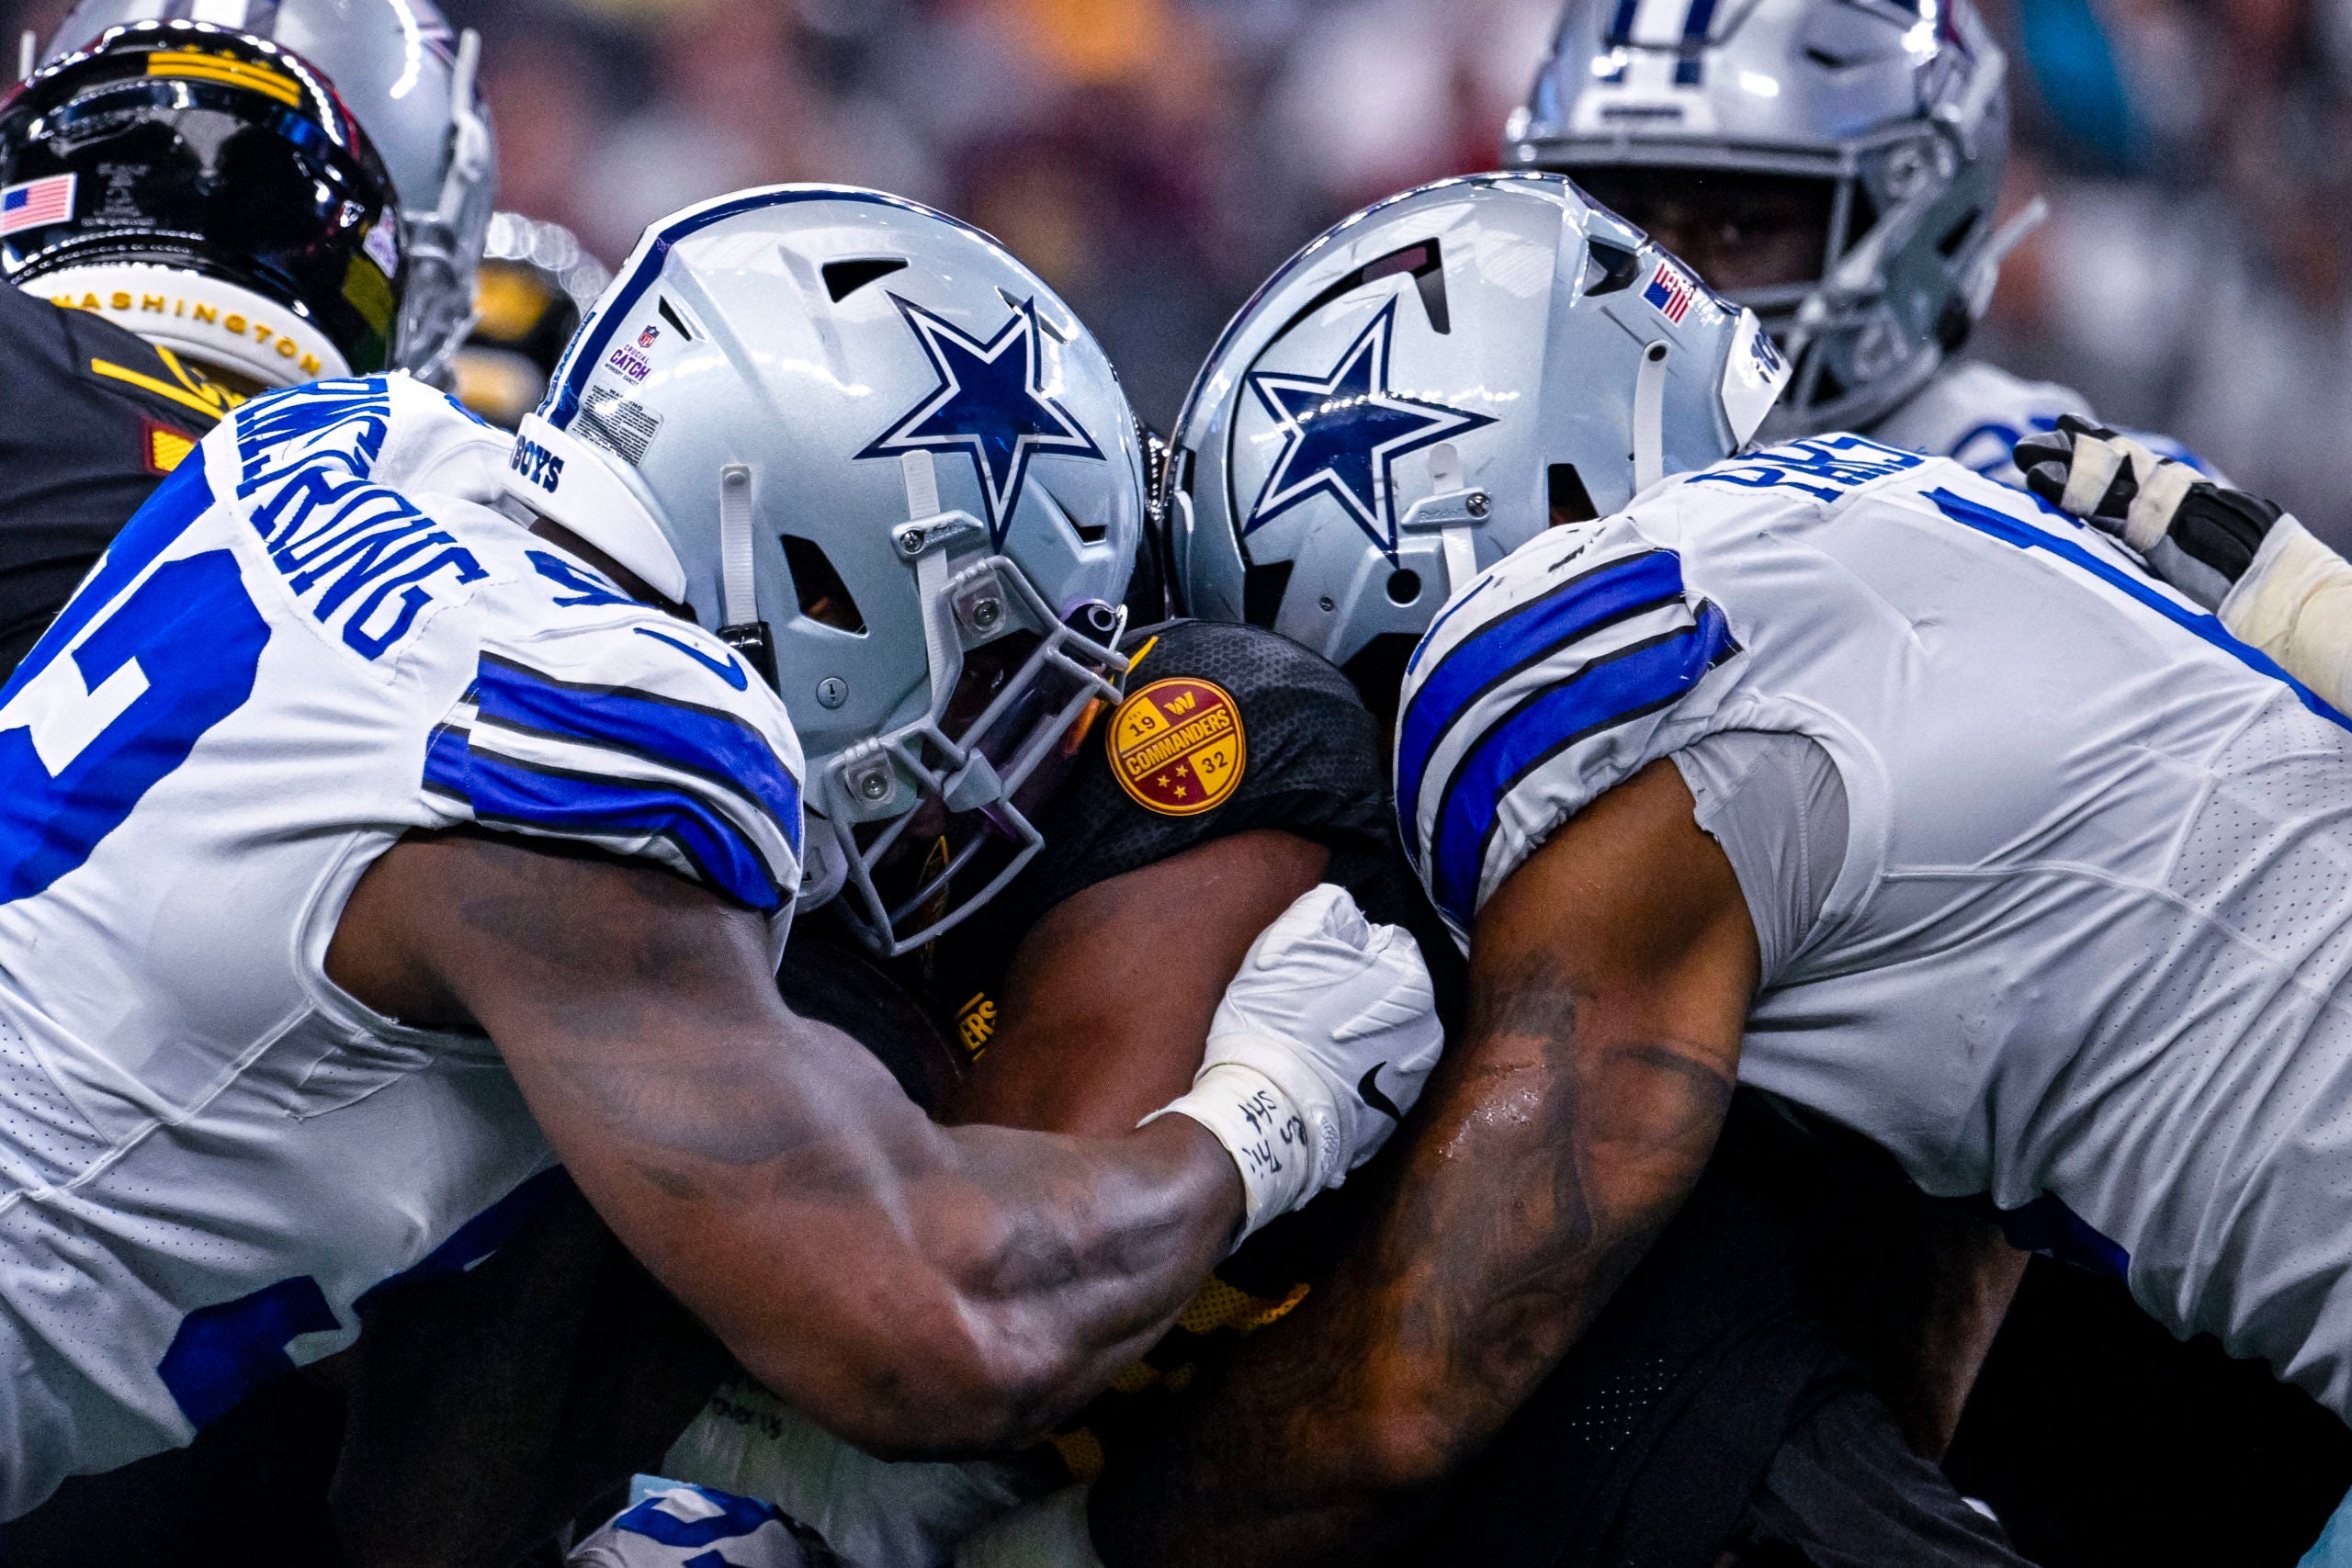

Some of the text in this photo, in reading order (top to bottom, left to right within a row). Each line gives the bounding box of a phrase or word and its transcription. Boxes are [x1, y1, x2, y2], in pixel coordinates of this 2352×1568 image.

[610, 349, 651, 381] CATCH
[624, 344, 650, 364] CRUCIAL
[1129, 716, 1156, 737] 19
[1125, 709, 1230, 776] COMMANDERS
[1202, 751, 1228, 773] 32
